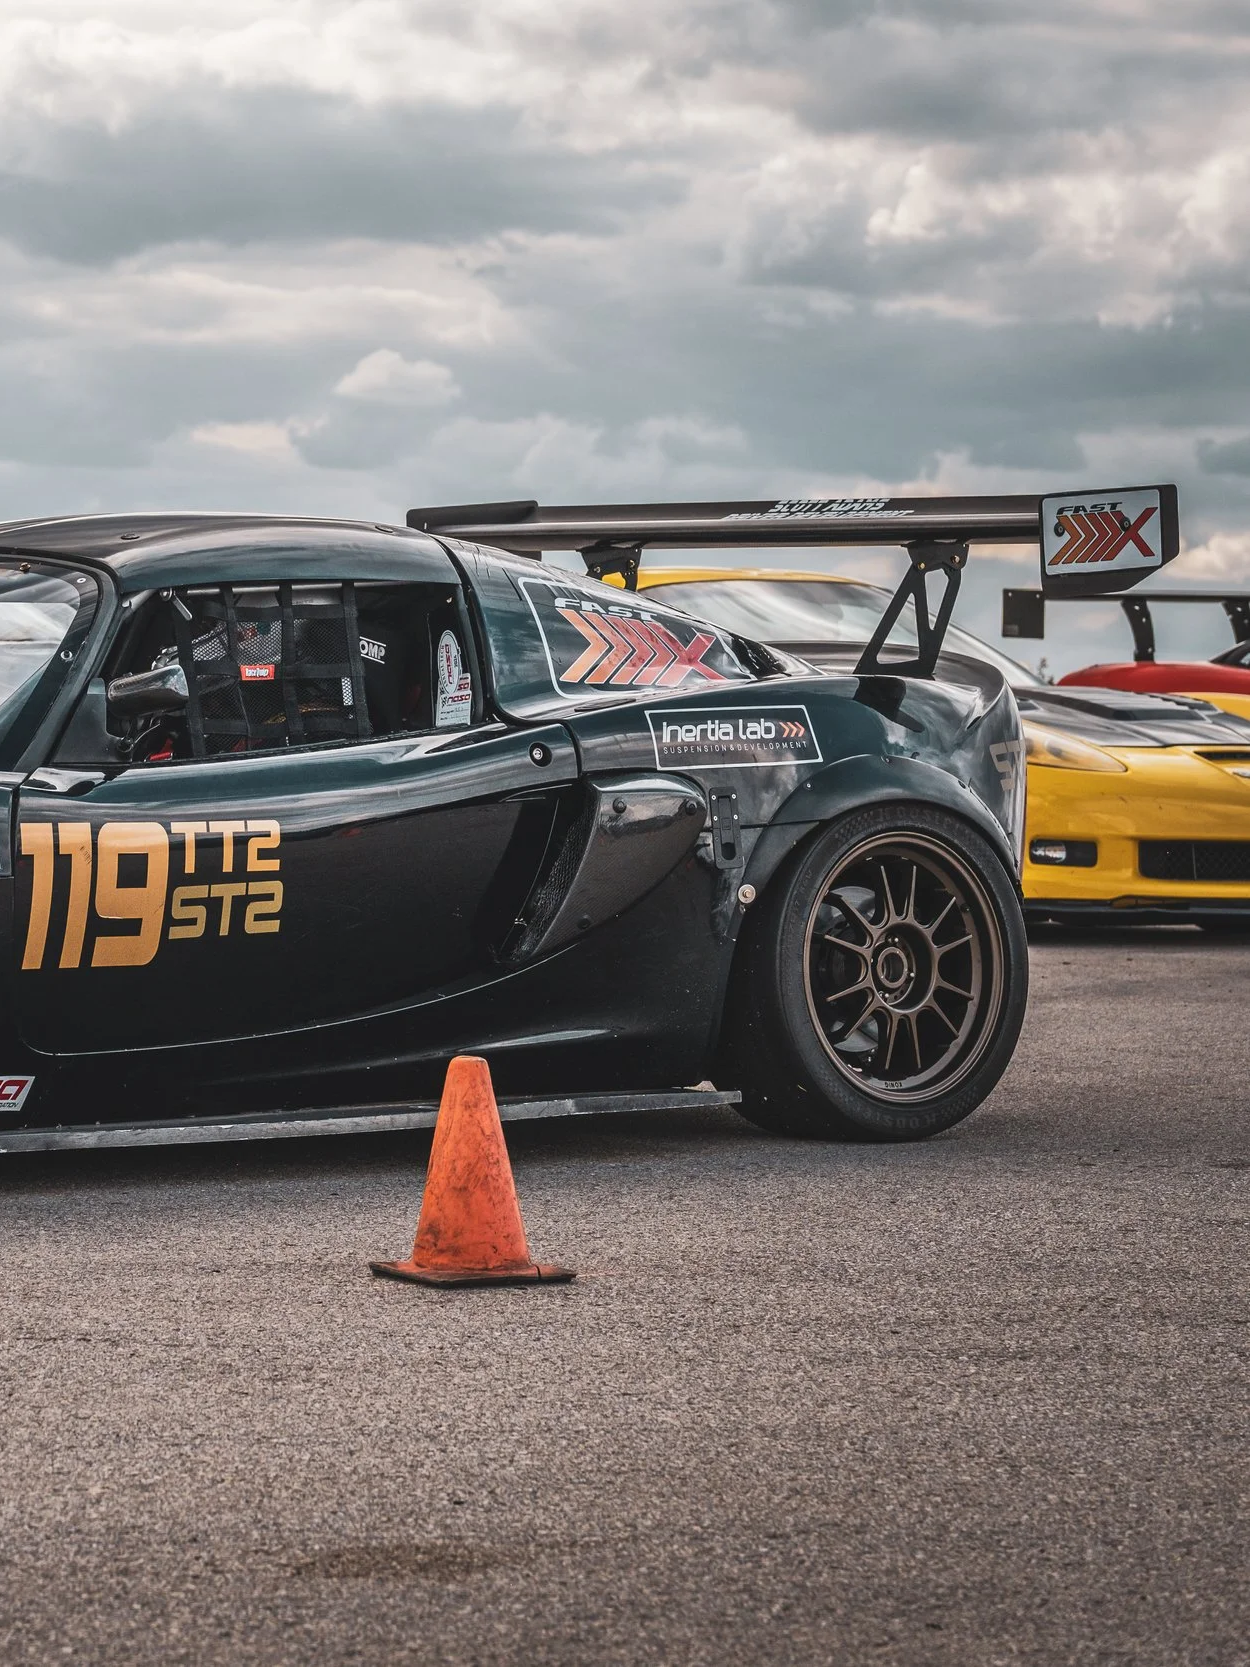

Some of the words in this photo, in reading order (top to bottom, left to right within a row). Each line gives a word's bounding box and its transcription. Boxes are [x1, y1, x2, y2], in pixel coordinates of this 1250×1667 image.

[1056, 502, 1123, 515] FAST
[555, 597, 657, 622] FAST
[359, 640, 386, 660] OMP
[662, 719, 734, 743] inertia
[738, 718, 776, 742] lab
[170, 819, 281, 874] TT2
[20, 821, 170, 970] 119
[168, 880, 284, 940] ST2
